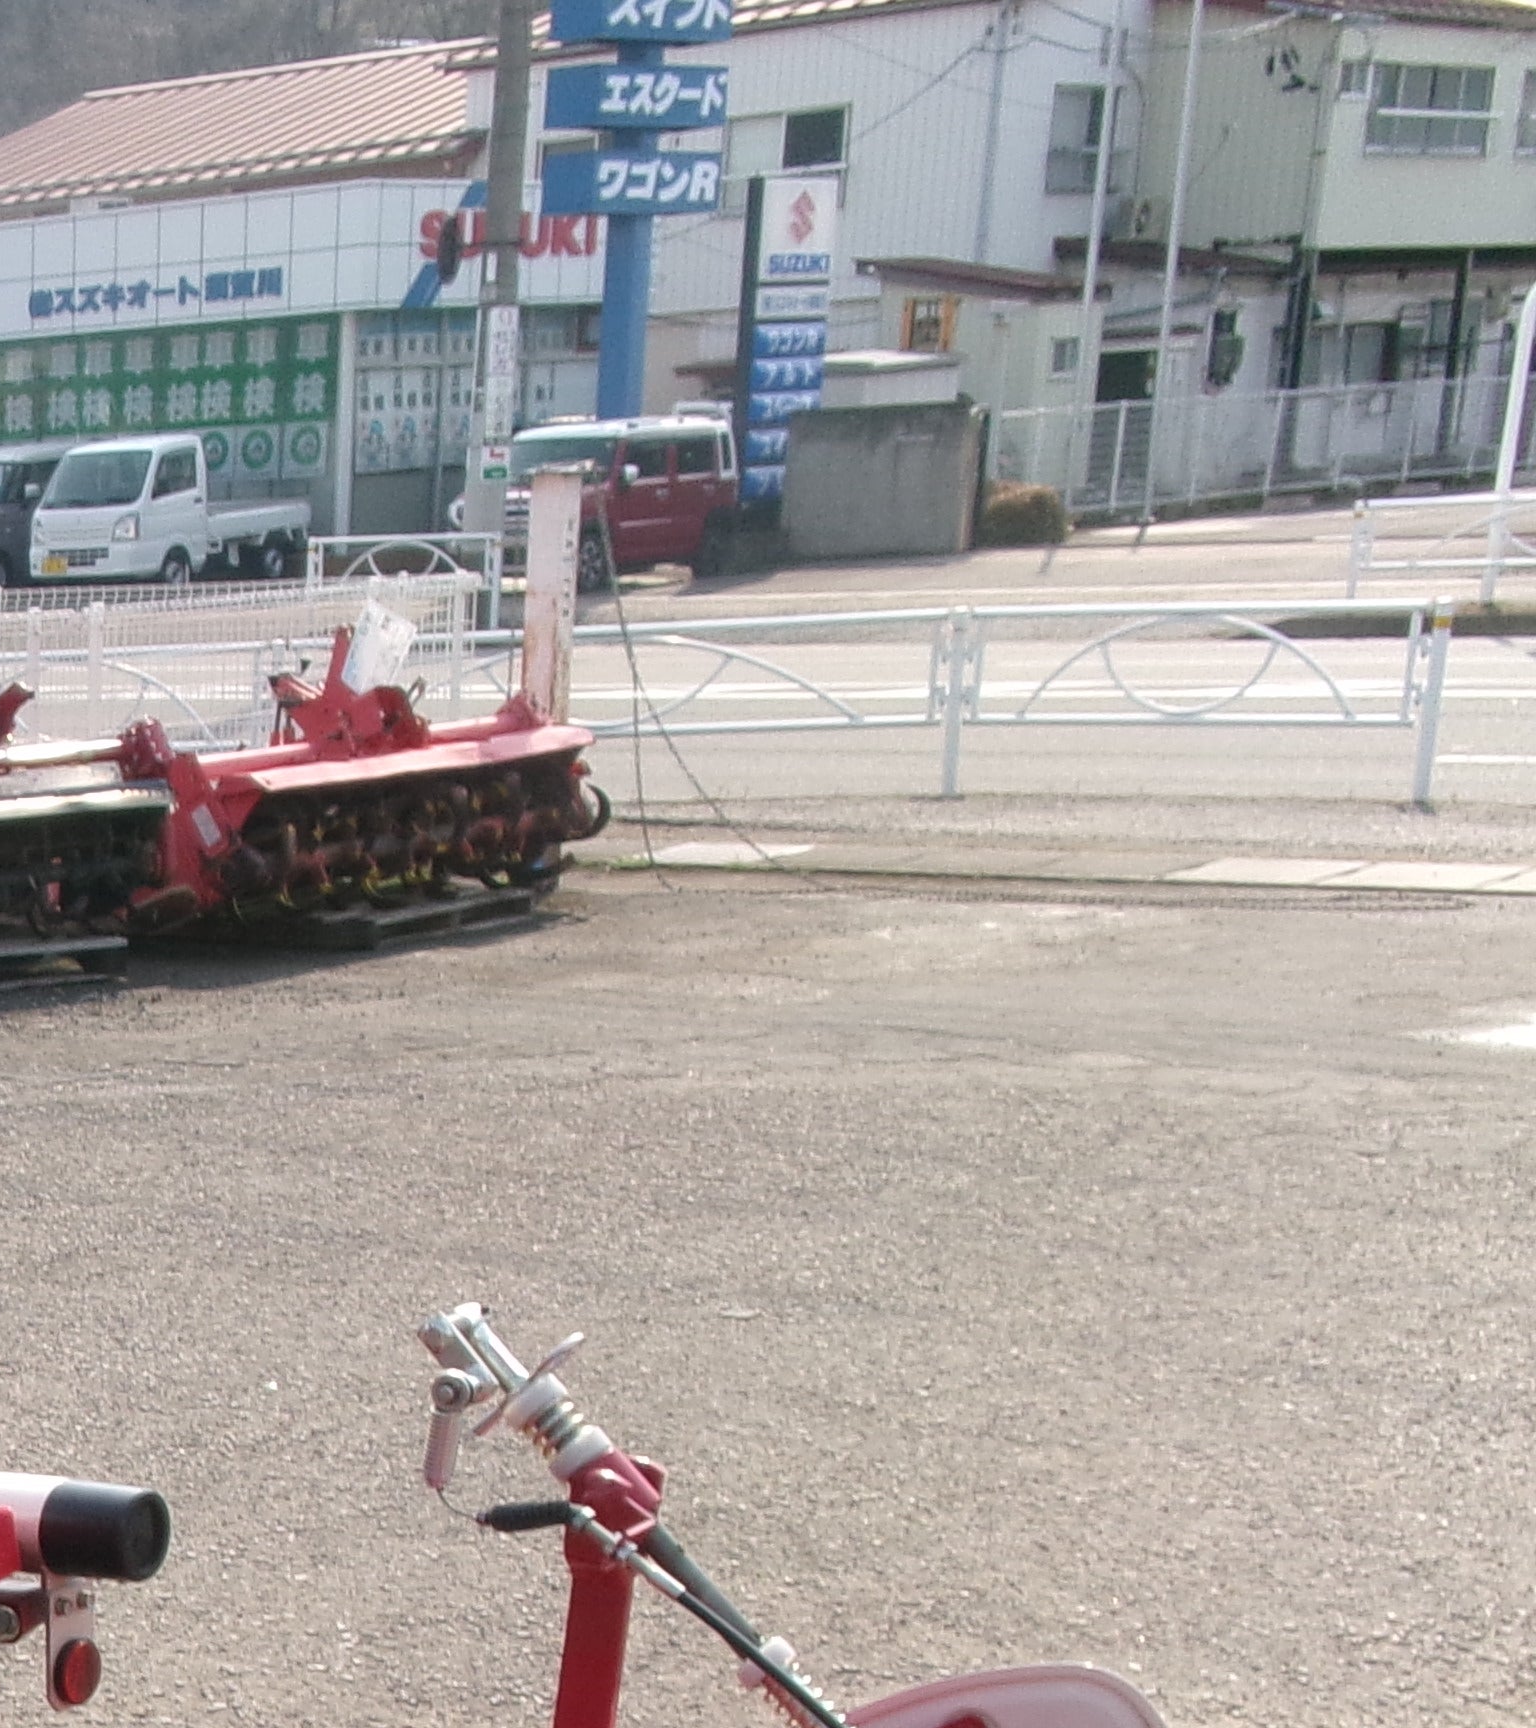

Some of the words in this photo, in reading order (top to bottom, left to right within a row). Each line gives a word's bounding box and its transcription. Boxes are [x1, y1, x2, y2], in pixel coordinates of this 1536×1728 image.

[599, 73, 727, 117] エスクード
[597, 159, 719, 202] ワゴンR
[420, 209, 599, 258] SUUKI
